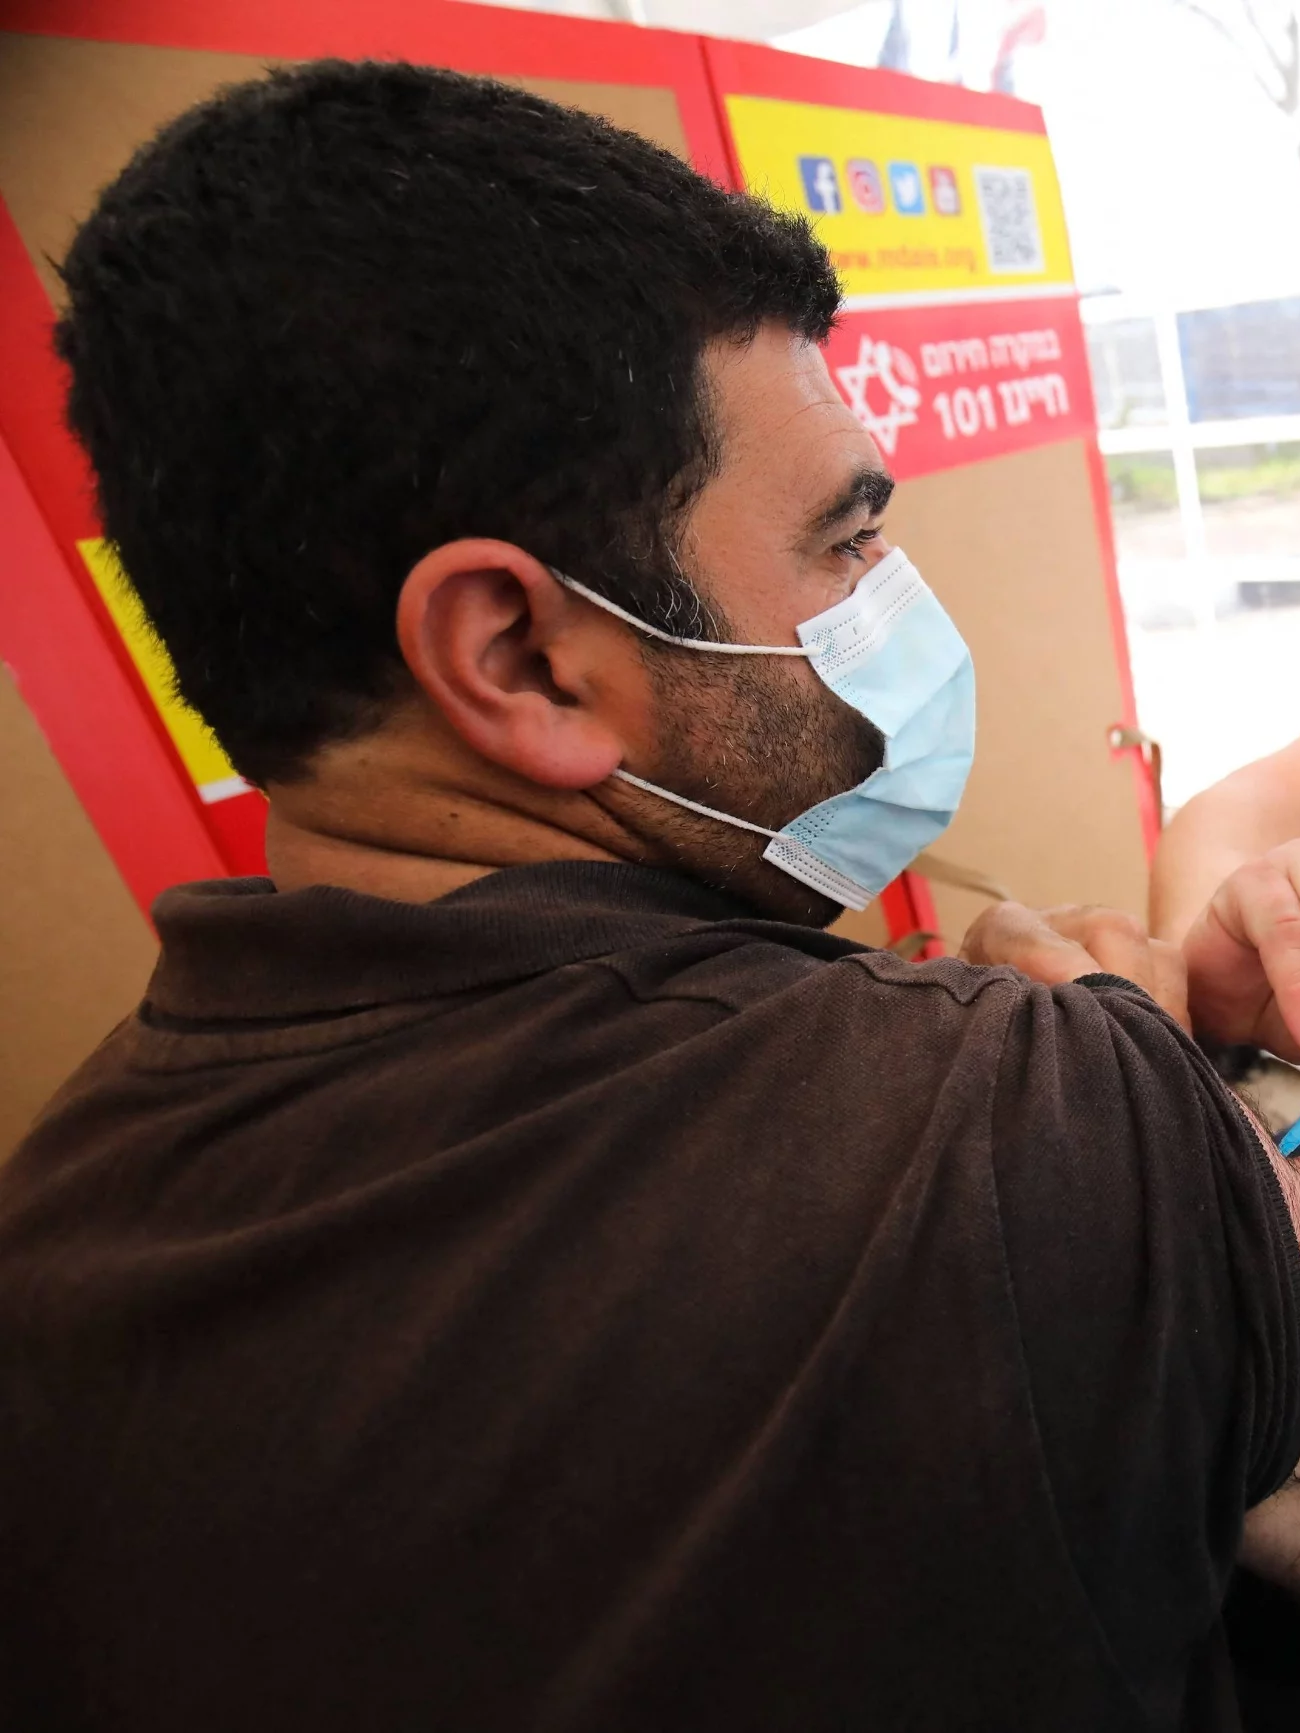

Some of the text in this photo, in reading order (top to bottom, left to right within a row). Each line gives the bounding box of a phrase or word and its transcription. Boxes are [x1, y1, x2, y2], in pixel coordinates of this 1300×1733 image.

[920, 328, 1062, 378] במקרה חירום
[932, 384, 998, 440] 101
